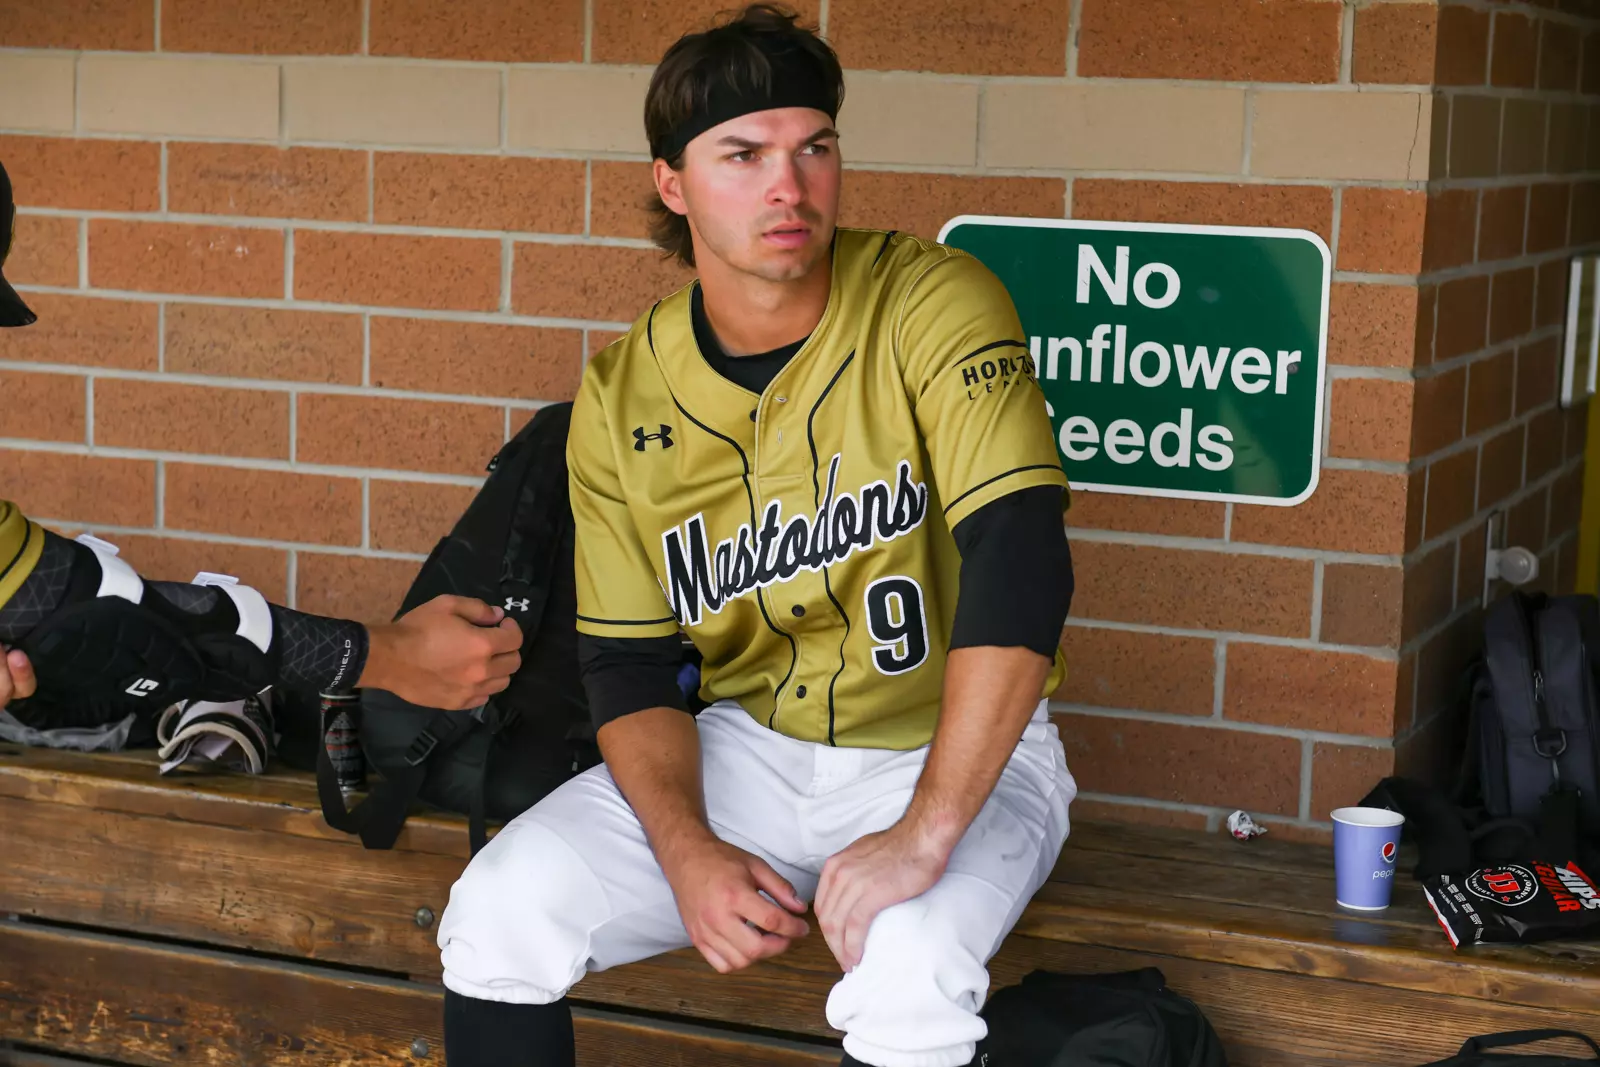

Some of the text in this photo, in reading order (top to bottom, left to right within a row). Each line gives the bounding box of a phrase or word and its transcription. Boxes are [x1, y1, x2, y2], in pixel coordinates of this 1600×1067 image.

[1076, 244, 1181, 309] No
[962, 354, 1035, 387] HORIZ
[1030, 324, 1302, 395] nflower
[1045, 400, 1234, 471] eeds
[659, 453, 928, 626] Mastodons
[864, 575, 930, 676] 9
[329, 639, 351, 689] OSHIELD
[1372, 868, 1395, 880] peps
[1533, 862, 1581, 912] GULAR
[1554, 866, 1600, 909] HIPS
